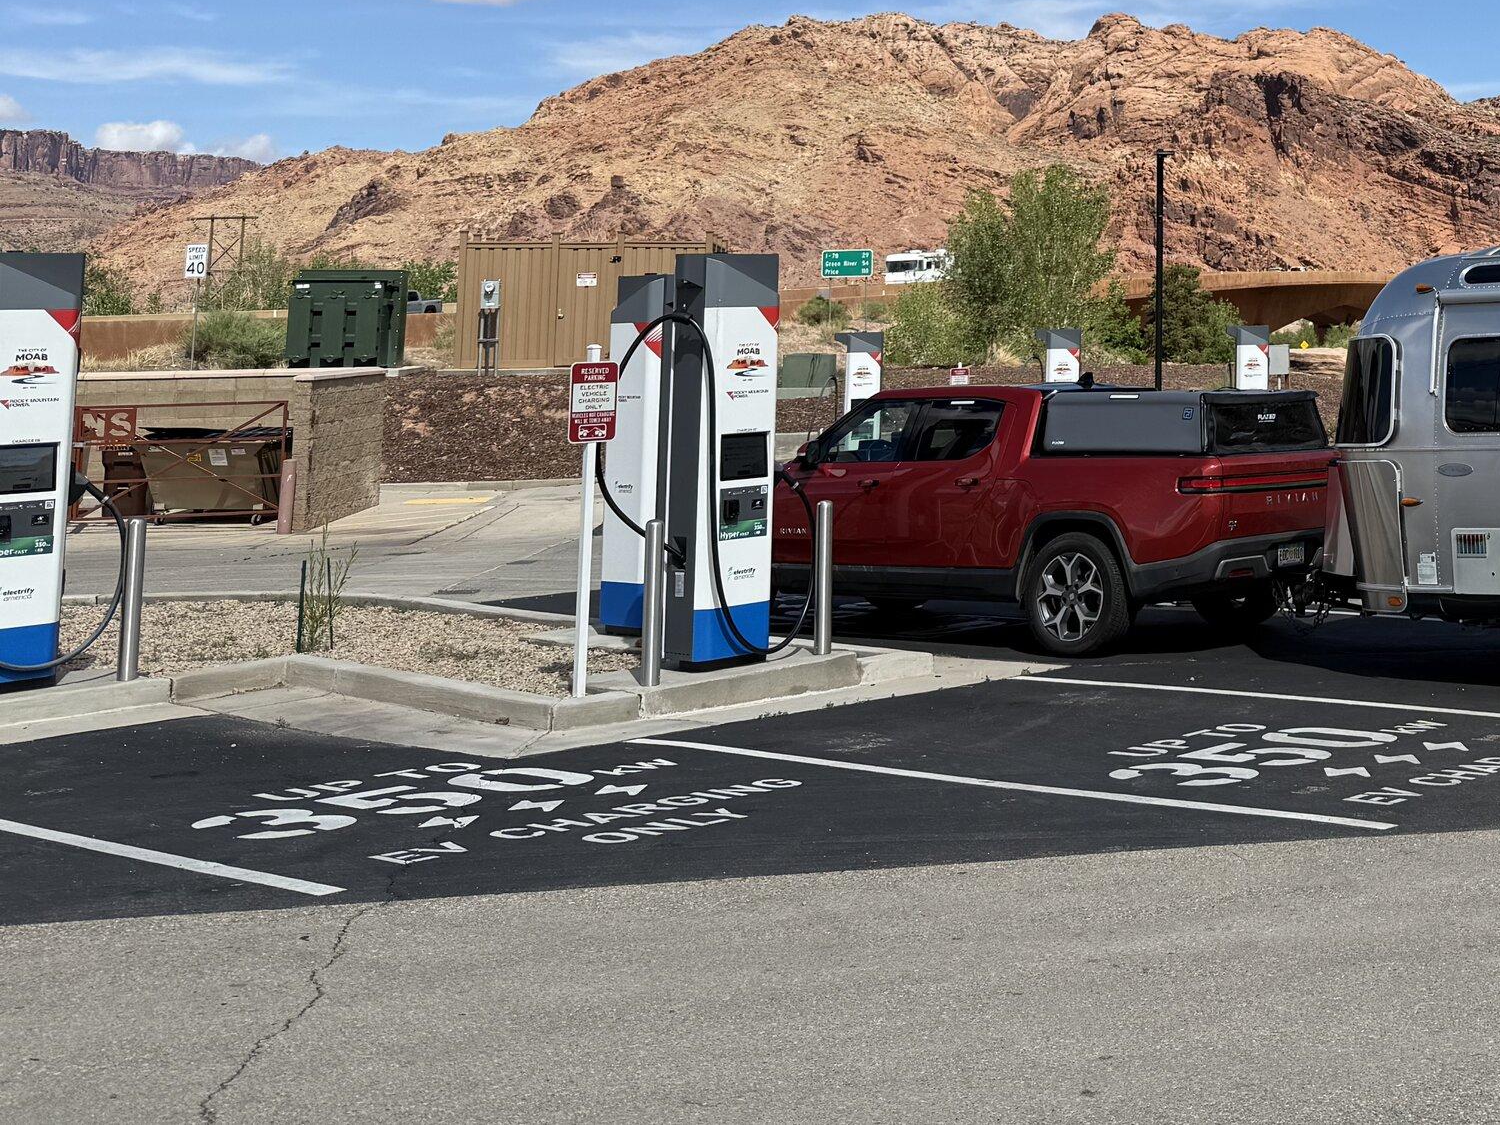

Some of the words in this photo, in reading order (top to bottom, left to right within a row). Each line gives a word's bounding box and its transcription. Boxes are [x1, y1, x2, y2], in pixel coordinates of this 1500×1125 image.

[186, 262, 205, 274] 40
[15, 353, 48, 362] MOAB
[1266, 492, 1319, 505] RIVIAN
[3, 587, 35, 595] electrify
[1107, 739, 1189, 757] UP
[1182, 723, 1266, 738] TO
[252, 780, 363, 801] UP
[374, 762, 482, 779] TO
[1342, 786, 1423, 806] EV
[367, 841, 469, 865] EV
[489, 778, 803, 840] CHARGING
[581, 807, 749, 844] ONLY
